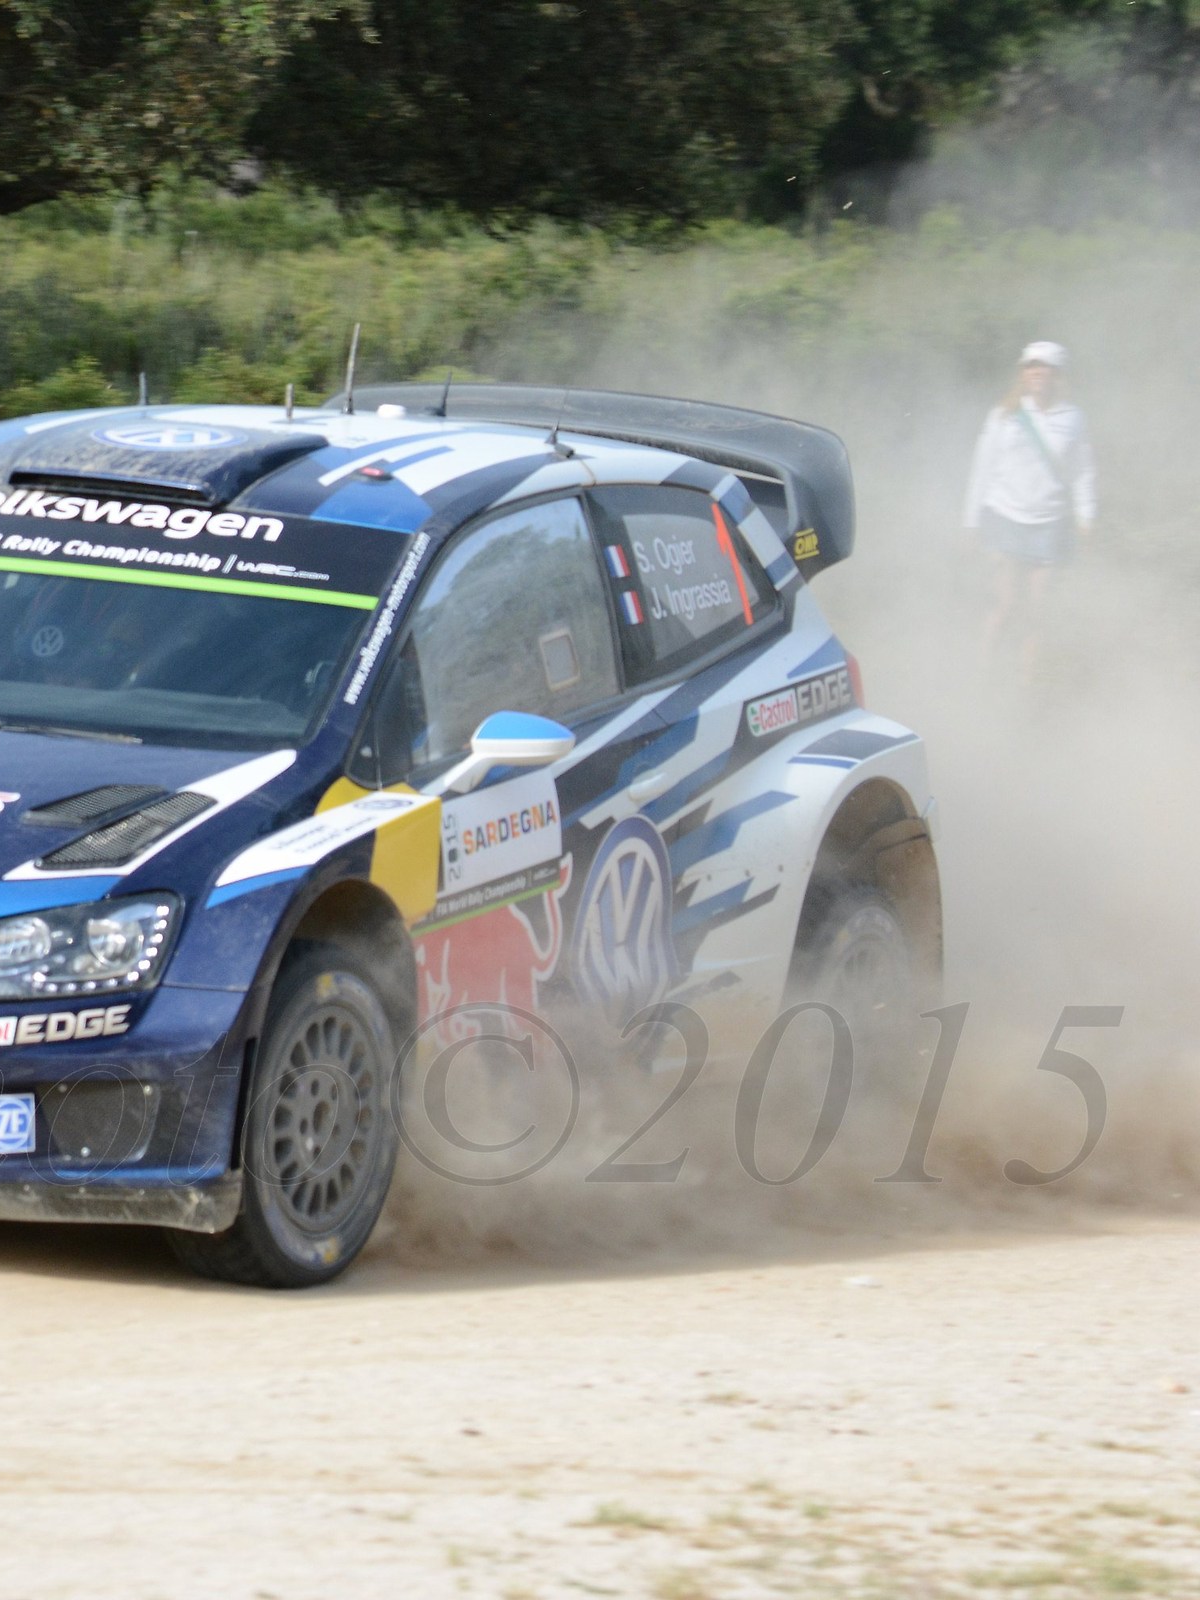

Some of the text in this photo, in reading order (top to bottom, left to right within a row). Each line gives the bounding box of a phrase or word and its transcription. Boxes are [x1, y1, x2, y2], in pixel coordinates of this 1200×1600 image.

[2, 534, 62, 556] Rally
[62, 539, 221, 573] Championship
[633, 534, 696, 575] S. Ogier
[794, 532, 819, 556] OMP
[651, 573, 732, 620] J. Ingrassia
[760, 668, 851, 730] Castrol EDGE
[443, 814, 461, 881] 2015
[463, 800, 557, 855] SARDEGNA
[16, 1004, 132, 1045] EDGE
